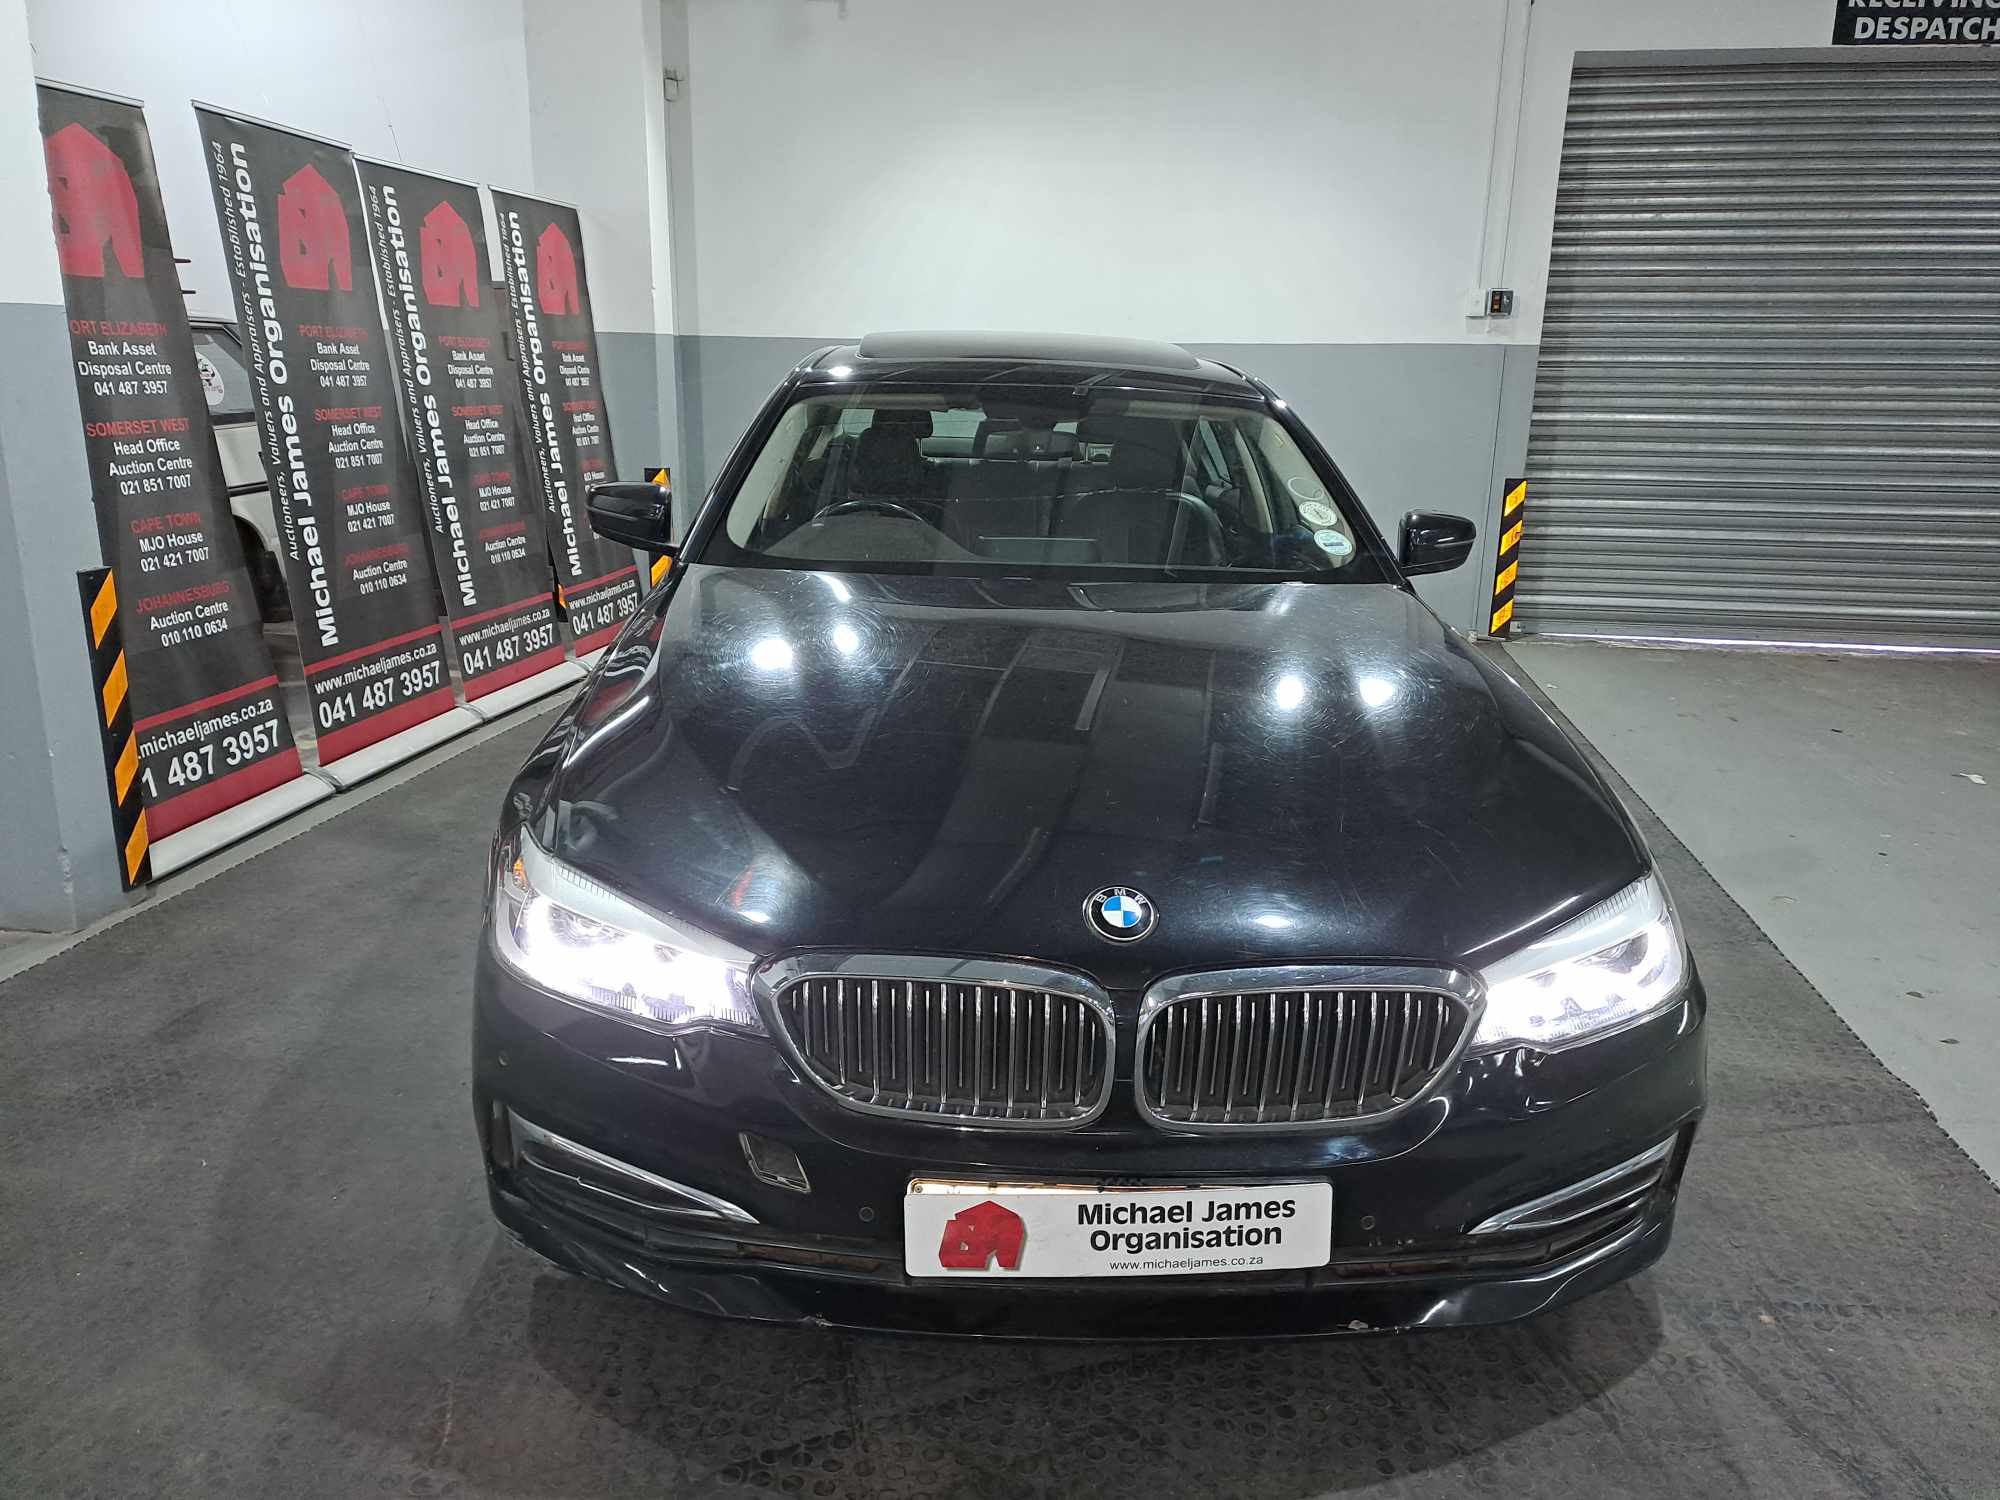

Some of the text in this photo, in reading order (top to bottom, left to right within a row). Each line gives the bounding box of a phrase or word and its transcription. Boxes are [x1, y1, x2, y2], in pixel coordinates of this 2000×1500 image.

[1854, 16, 2000, 40] DESPATCH
[378, 222, 396, 297] Established
[70, 320, 96, 336] ORT
[87, 340, 158, 356] Bank Asset
[211, 140, 300, 561] Auctioneers, Valuers and Appraisers Established 1964
[316, 342, 339, 355] Bank
[77, 361, 172, 379] Disposal Centre
[310, 358, 371, 373] Disposal Centre
[94, 380, 168, 396] 041 487 3957
[320, 375, 334, 388] 041
[335, 375, 350, 388] 487
[230, 141, 340, 648] Michael James Organisation
[382, 185, 477, 607] Michael James Organisation
[508, 211, 583, 577] Michael James Organisation
[86, 417, 190, 437] SOMERSET WEST
[331, 422, 376, 437] Head Office
[113, 438, 180, 456] Head Office
[328, 438, 384, 454] Auction Centre
[109, 456, 193, 477] Auction Centre
[335, 456, 350, 469] 021
[350, 454, 365, 468] 851
[120, 474, 192, 496] 021 851 7007
[422, 456, 444, 534] Auctioneers,
[346, 500, 391, 517] MJO House
[129, 511, 202, 534] CAPE TOWN
[347, 520, 361, 533] 021
[362, 516, 376, 530] 421
[139, 531, 204, 553] MJO House
[140, 546, 209, 573] 021 421 7007
[353, 559, 408, 580] Auction Centre
[360, 573, 407, 595] 010 110 0634
[150, 601, 229, 631] Auction Centre
[572, 592, 638, 635] 041 487 3957
[161, 618, 228, 647] 010 110 0634
[458, 608, 550, 646] www.michaeljames.co.za
[463, 622, 553, 675] 041 487 3957
[314, 643, 437, 695] www.michaeljames.co.za
[319, 660, 440, 729] 041 487 3957
[137, 698, 274, 760] .michaeljames.co.za
[167, 743, 214, 787] 487
[222, 718, 279, 767] 3957
[1096, 887, 1147, 905] BMW
[1077, 1199, 1296, 1226] Michael James
[1089, 1224, 1282, 1255] Organisation
[1109, 1255, 1264, 1271] www.michaeljames.co.za
